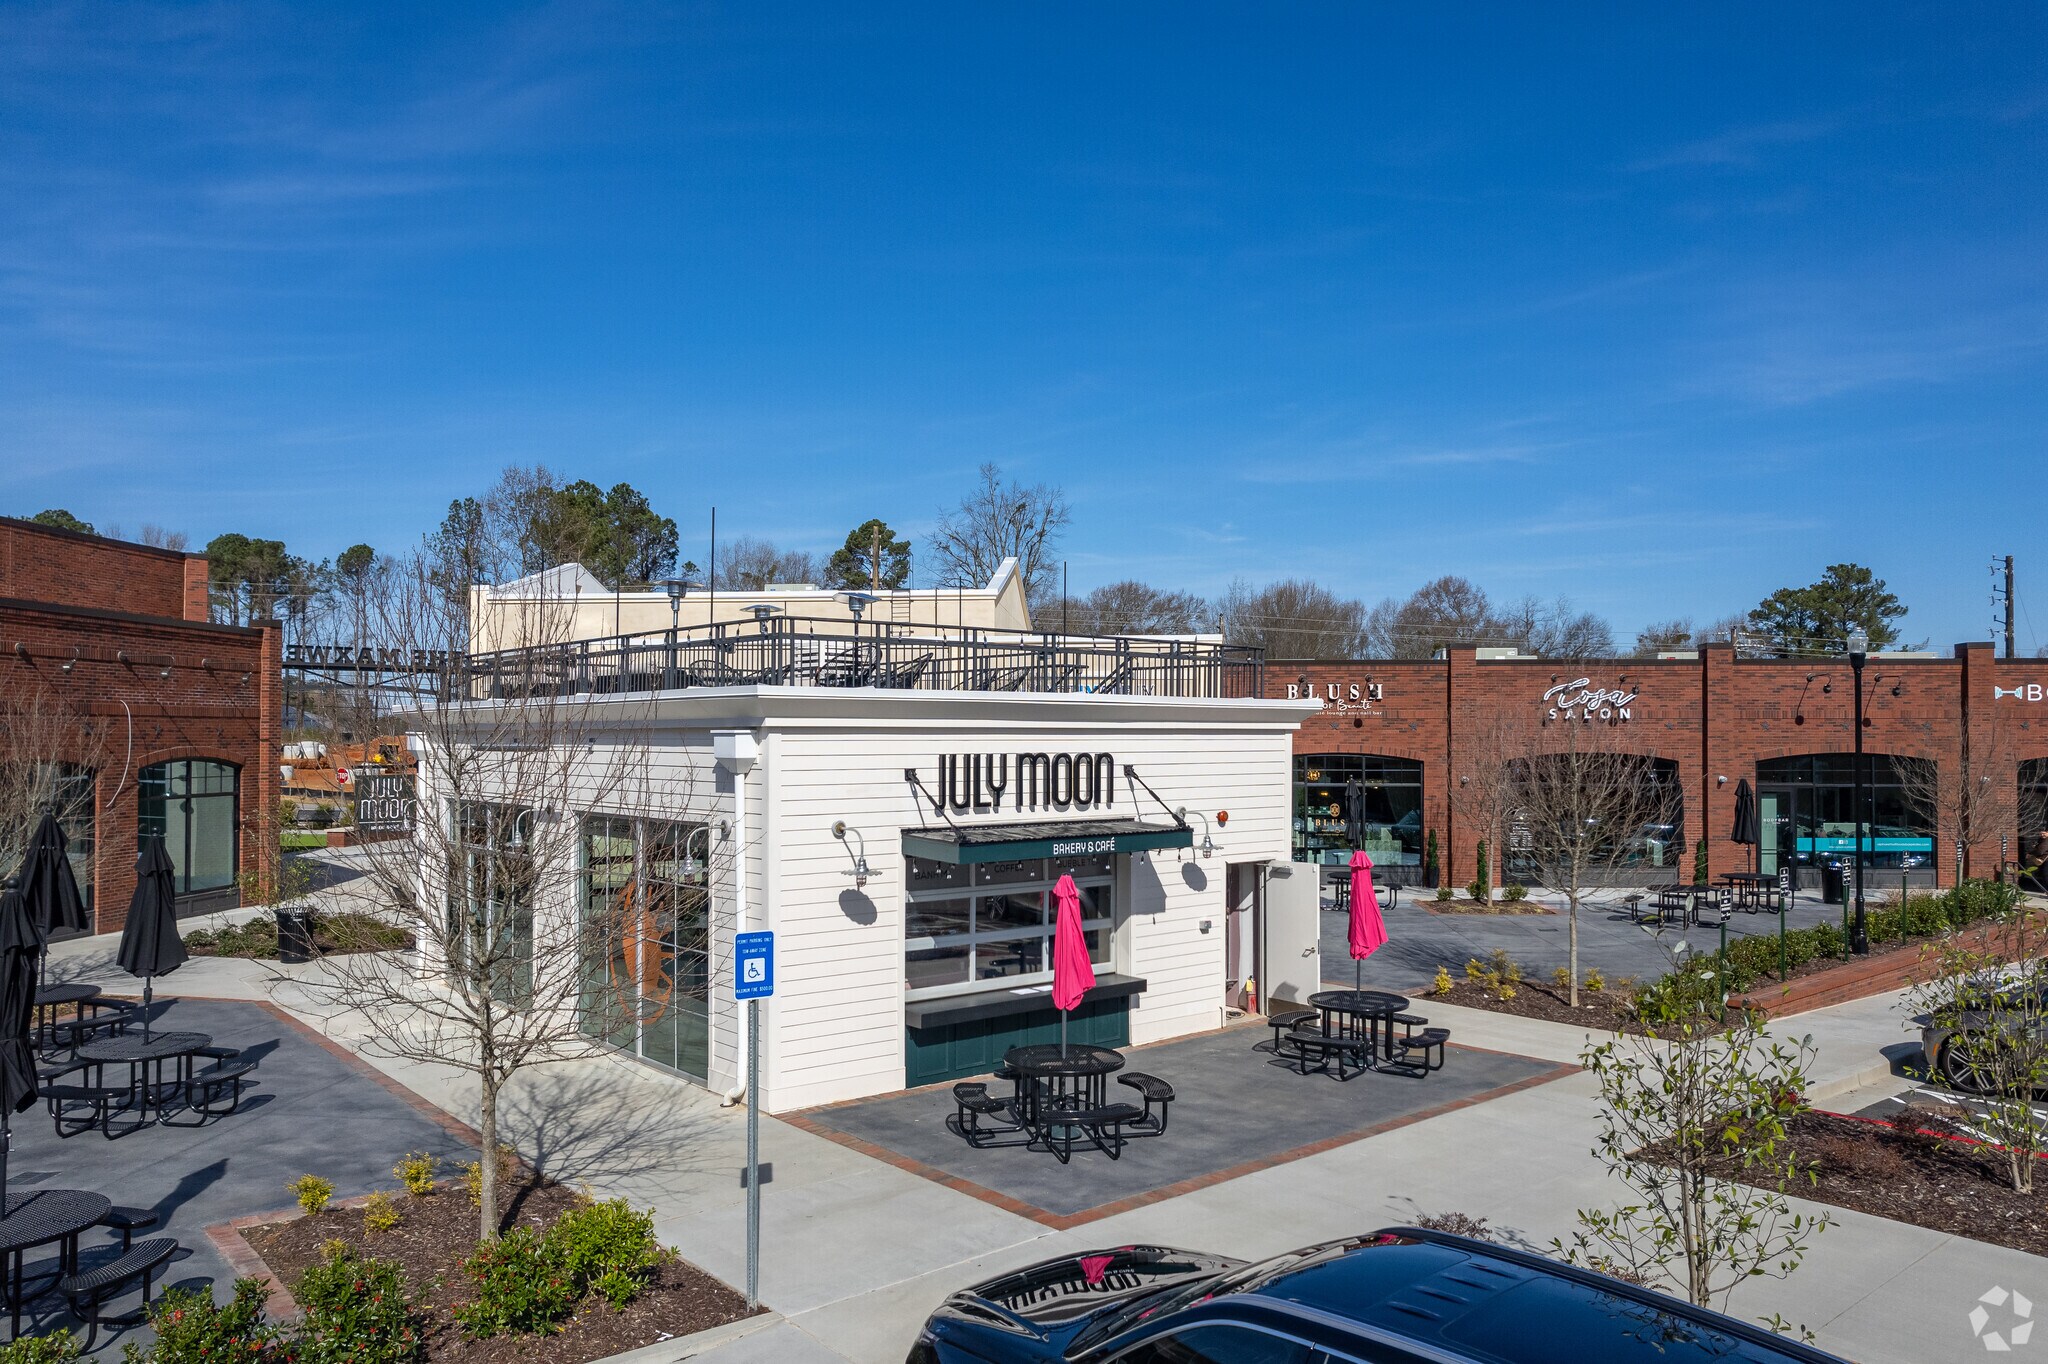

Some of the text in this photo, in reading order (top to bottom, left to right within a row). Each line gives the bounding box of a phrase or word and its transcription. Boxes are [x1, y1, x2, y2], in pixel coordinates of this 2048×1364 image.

[1286, 683, 1383, 700] BLUSH
[2027, 684, 2048, 701] B
[1549, 708, 1631, 719] SALON
[370, 778, 402, 798] JULY
[936, 752, 1114, 810] JULY MOON
[1053, 836, 1115, 855] BAKERY & CAFÉ
[994, 863, 1024, 873] COFFEE
